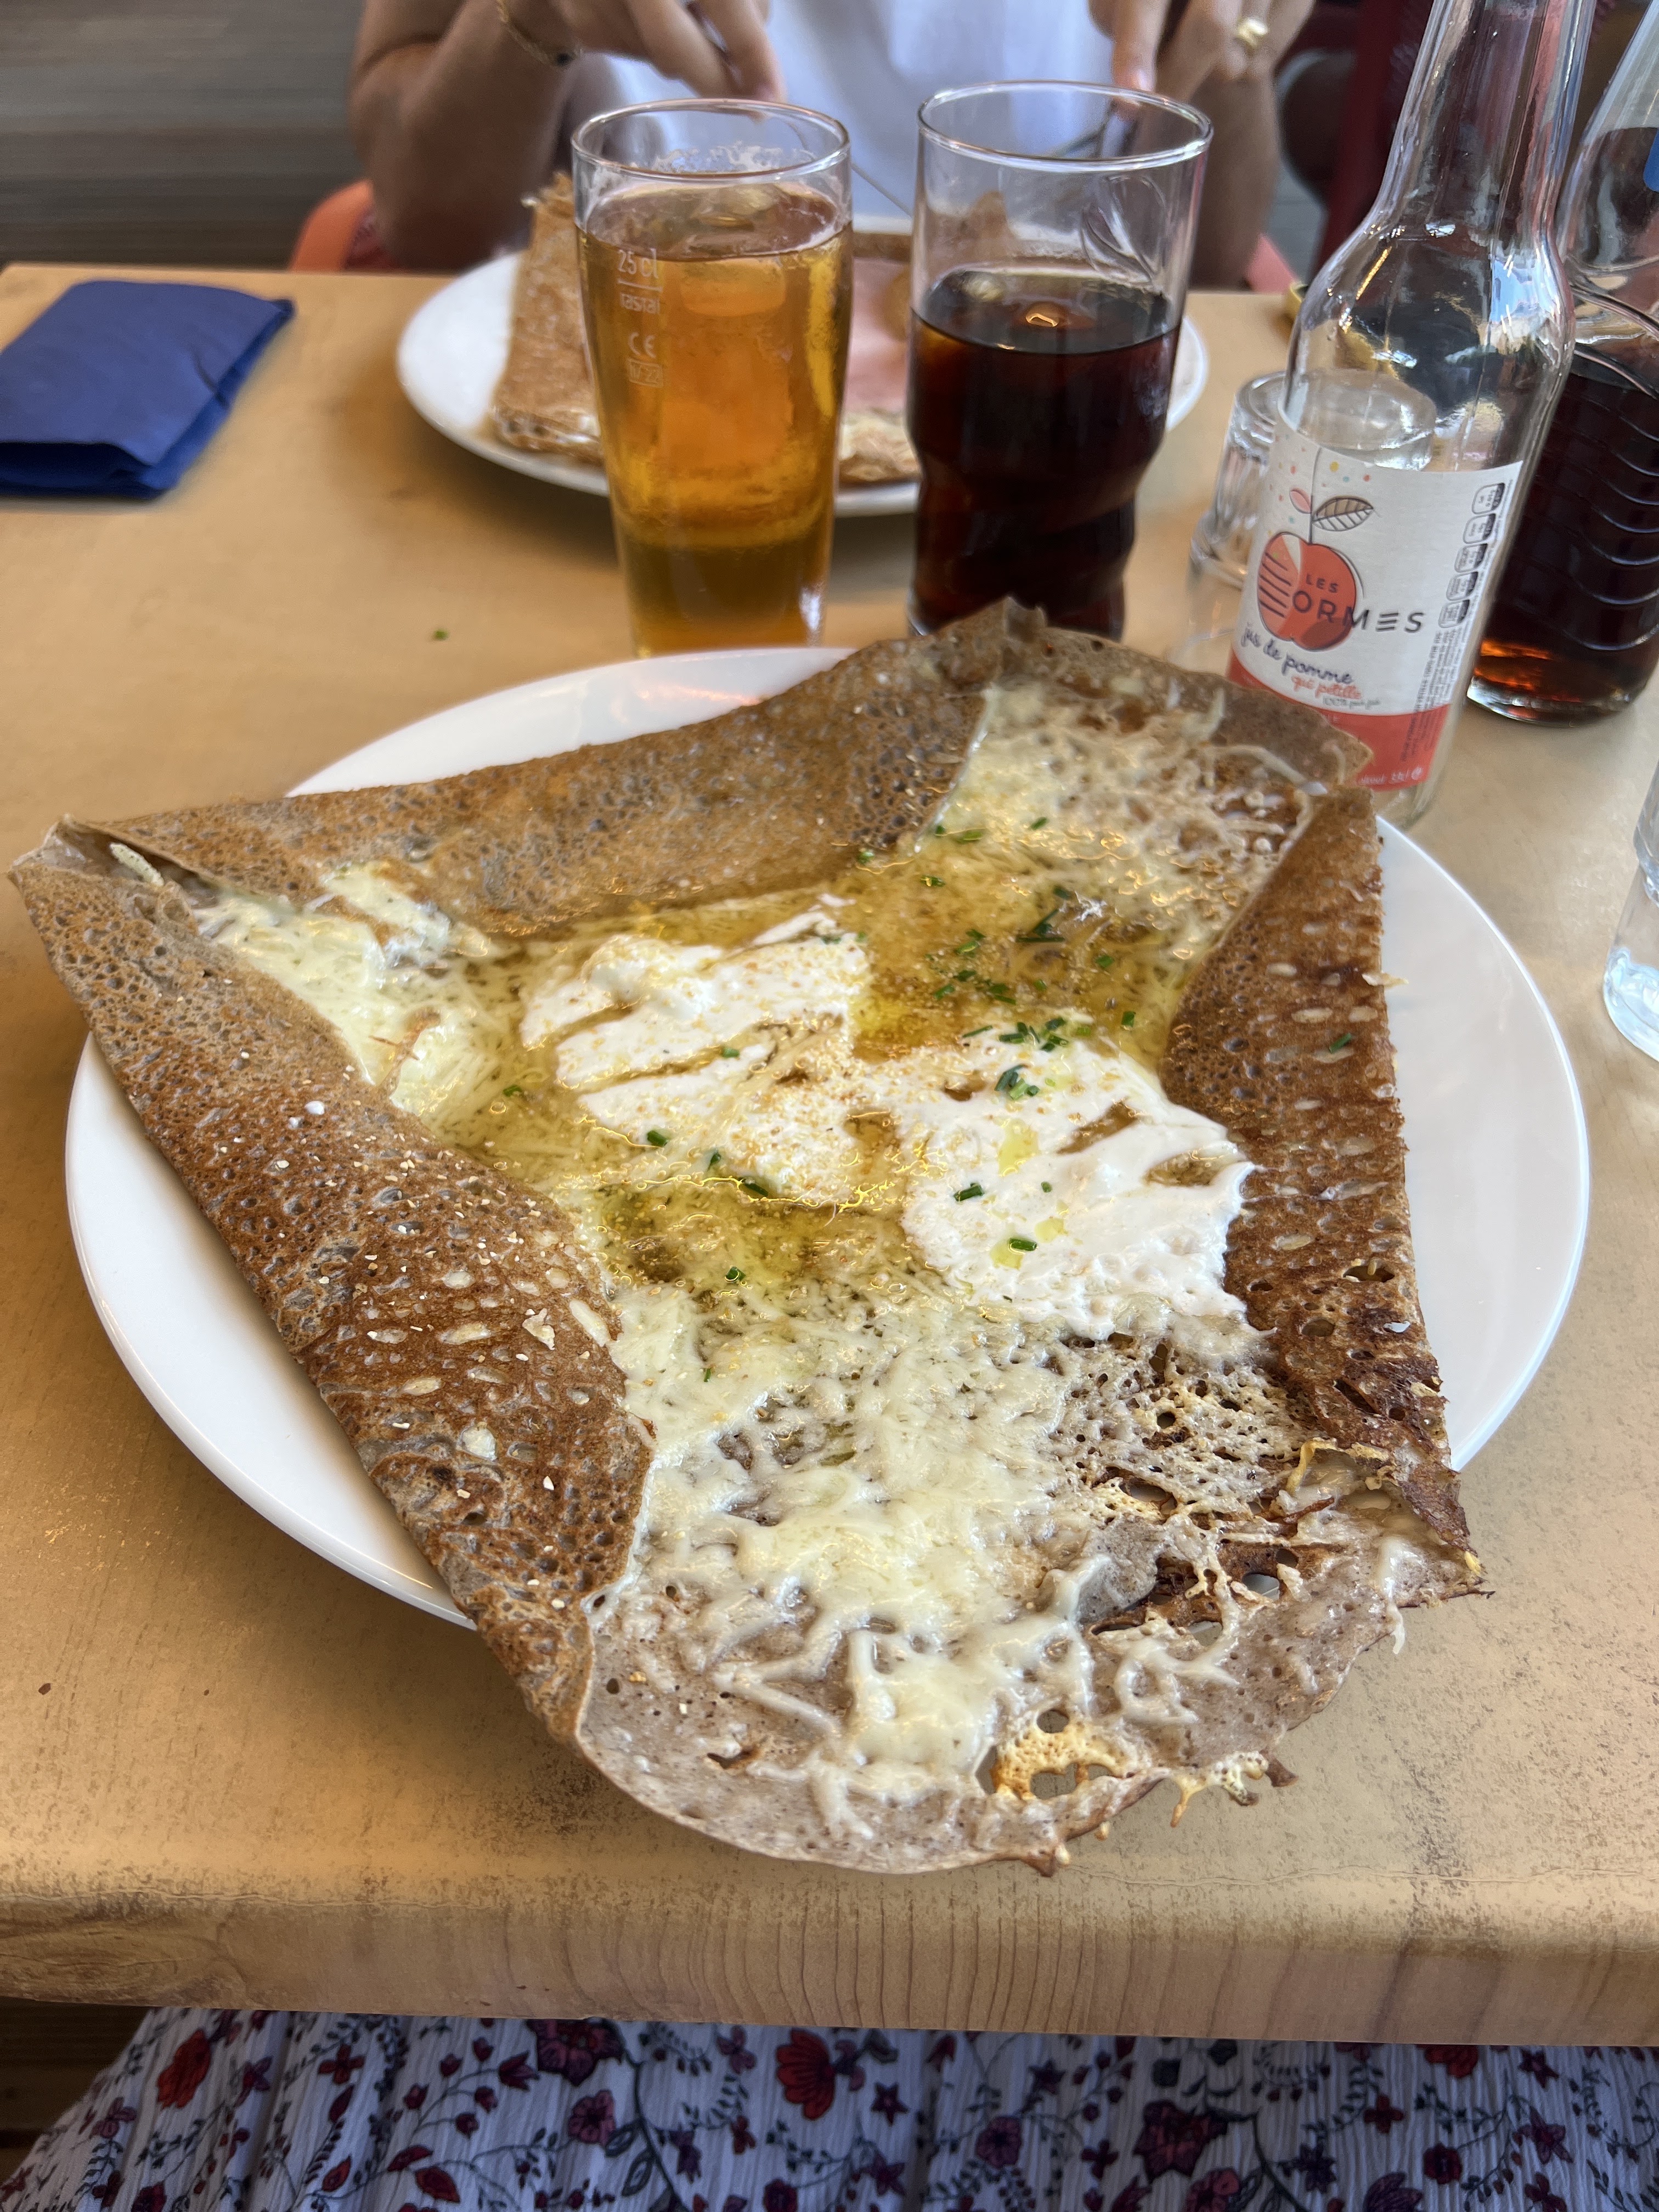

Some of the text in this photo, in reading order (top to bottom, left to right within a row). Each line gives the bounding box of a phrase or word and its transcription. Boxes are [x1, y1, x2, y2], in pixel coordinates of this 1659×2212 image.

[617, 249, 637, 275] 25
[1305, 574, 1339, 594] LES
[1292, 590, 1425, 633] ORMES
[1281, 652, 1355, 685] pomme
